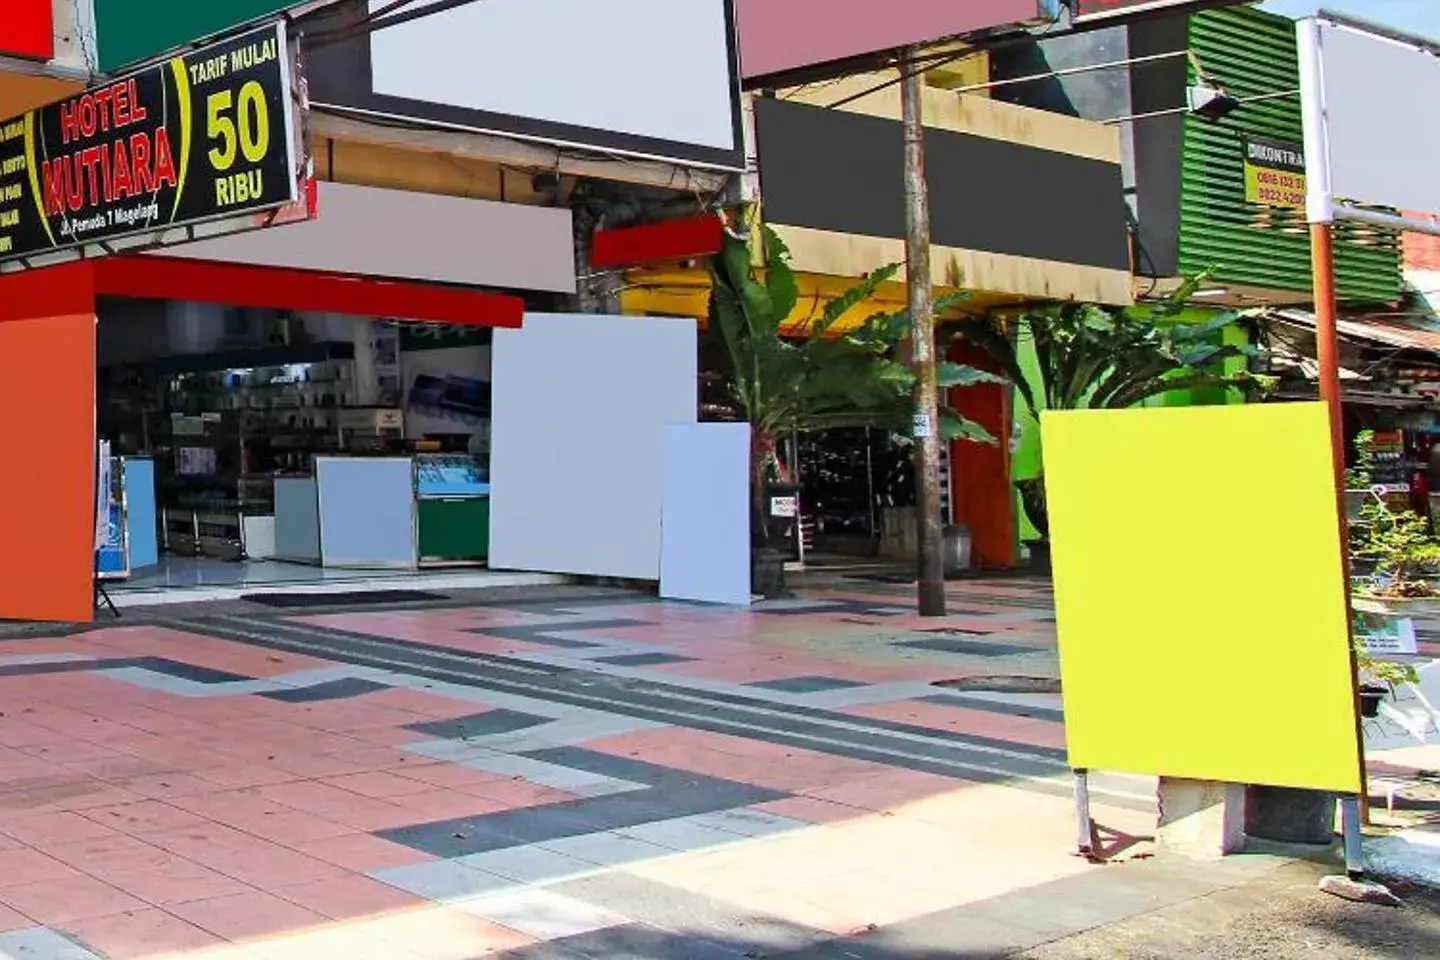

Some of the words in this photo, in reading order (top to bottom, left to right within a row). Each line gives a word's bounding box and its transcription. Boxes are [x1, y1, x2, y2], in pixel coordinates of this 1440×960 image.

[190, 53, 228, 85] TARIF
[231, 38, 277, 72] MULAI
[60, 78, 147, 144] HOTEL
[207, 80, 270, 170] 50
[41, 126, 177, 217] MUTIARA
[215, 169, 262, 207] RIBU
